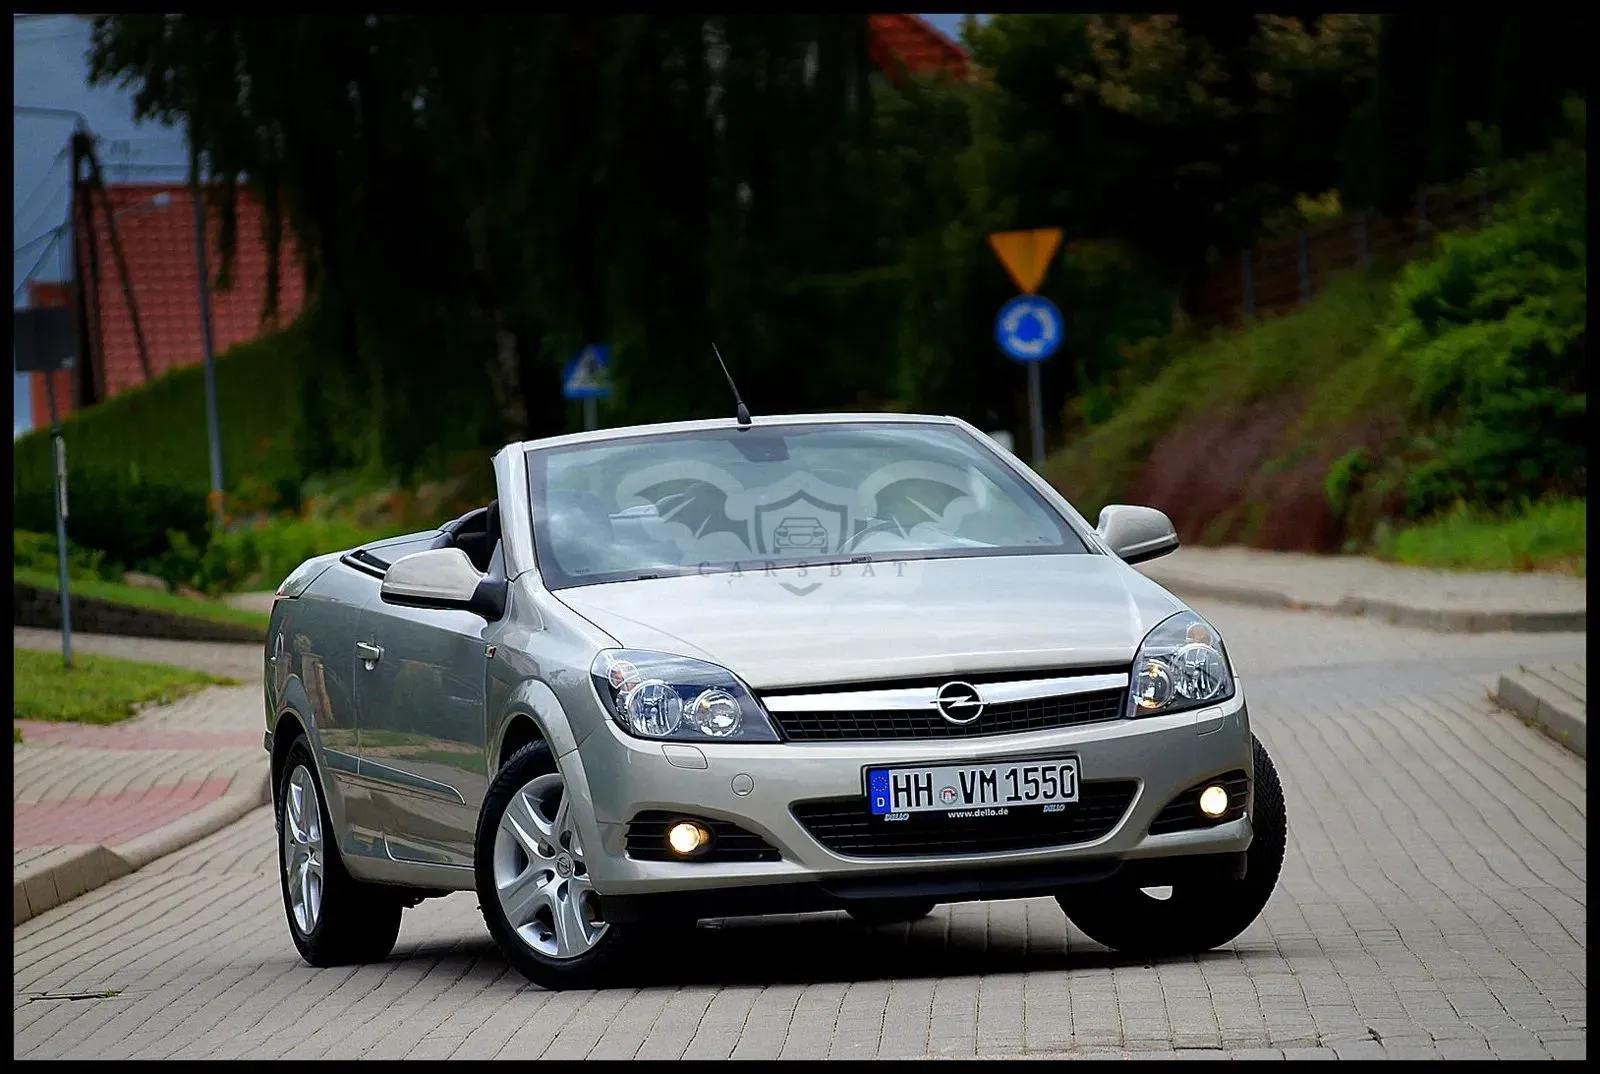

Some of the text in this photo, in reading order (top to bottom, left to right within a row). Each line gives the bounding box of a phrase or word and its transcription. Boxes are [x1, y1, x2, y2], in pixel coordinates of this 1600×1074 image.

[892, 765, 1075, 808] HH VM 1550
[876, 797, 885, 808] D
[947, 808, 1009, 819] www.dello.de
